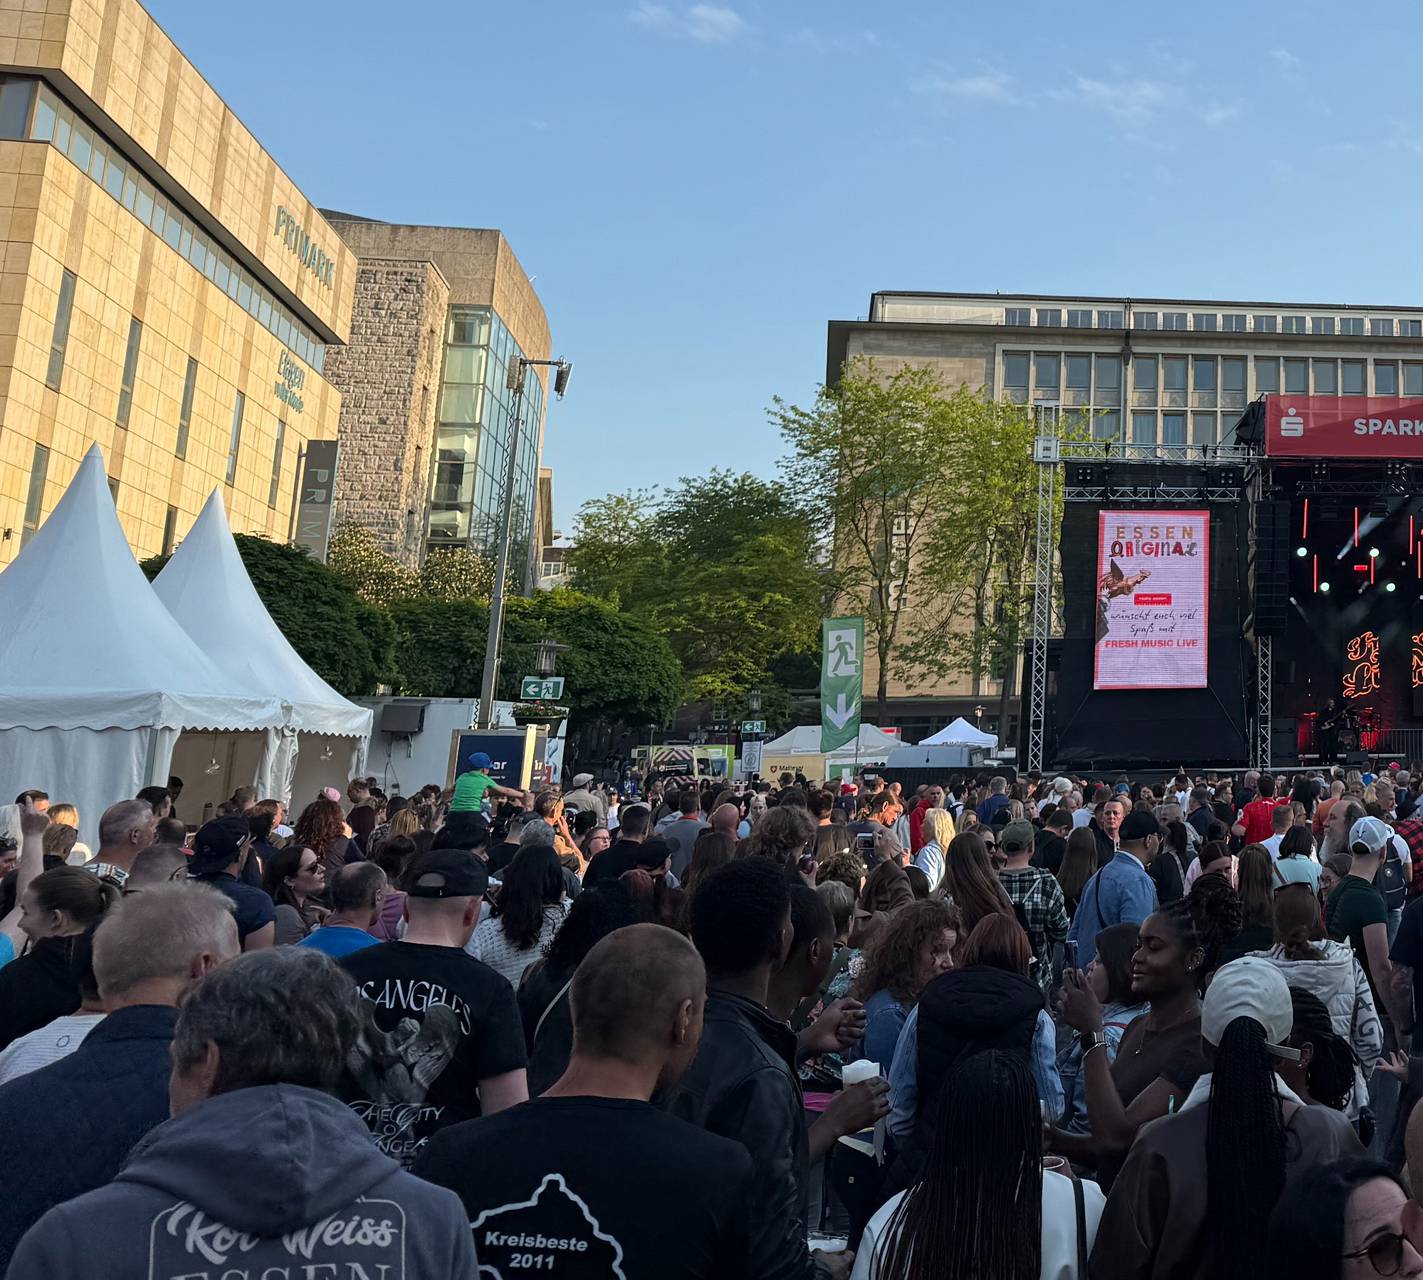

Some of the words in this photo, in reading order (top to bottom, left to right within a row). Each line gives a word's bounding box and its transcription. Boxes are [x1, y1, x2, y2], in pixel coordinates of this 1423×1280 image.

[274, 205, 335, 291] PRIMARK
[1116, 526, 1194, 540] ESSEN
[1105, 639, 1138, 649] FRESH
[1141, 639, 1174, 648] MUSIC
[1176, 638, 1198, 648] LIVE
[282, 1209, 400, 1259] Weiss
[485, 1231, 588, 1252] Kreisbeste
[509, 1253, 555, 1270] 2011
